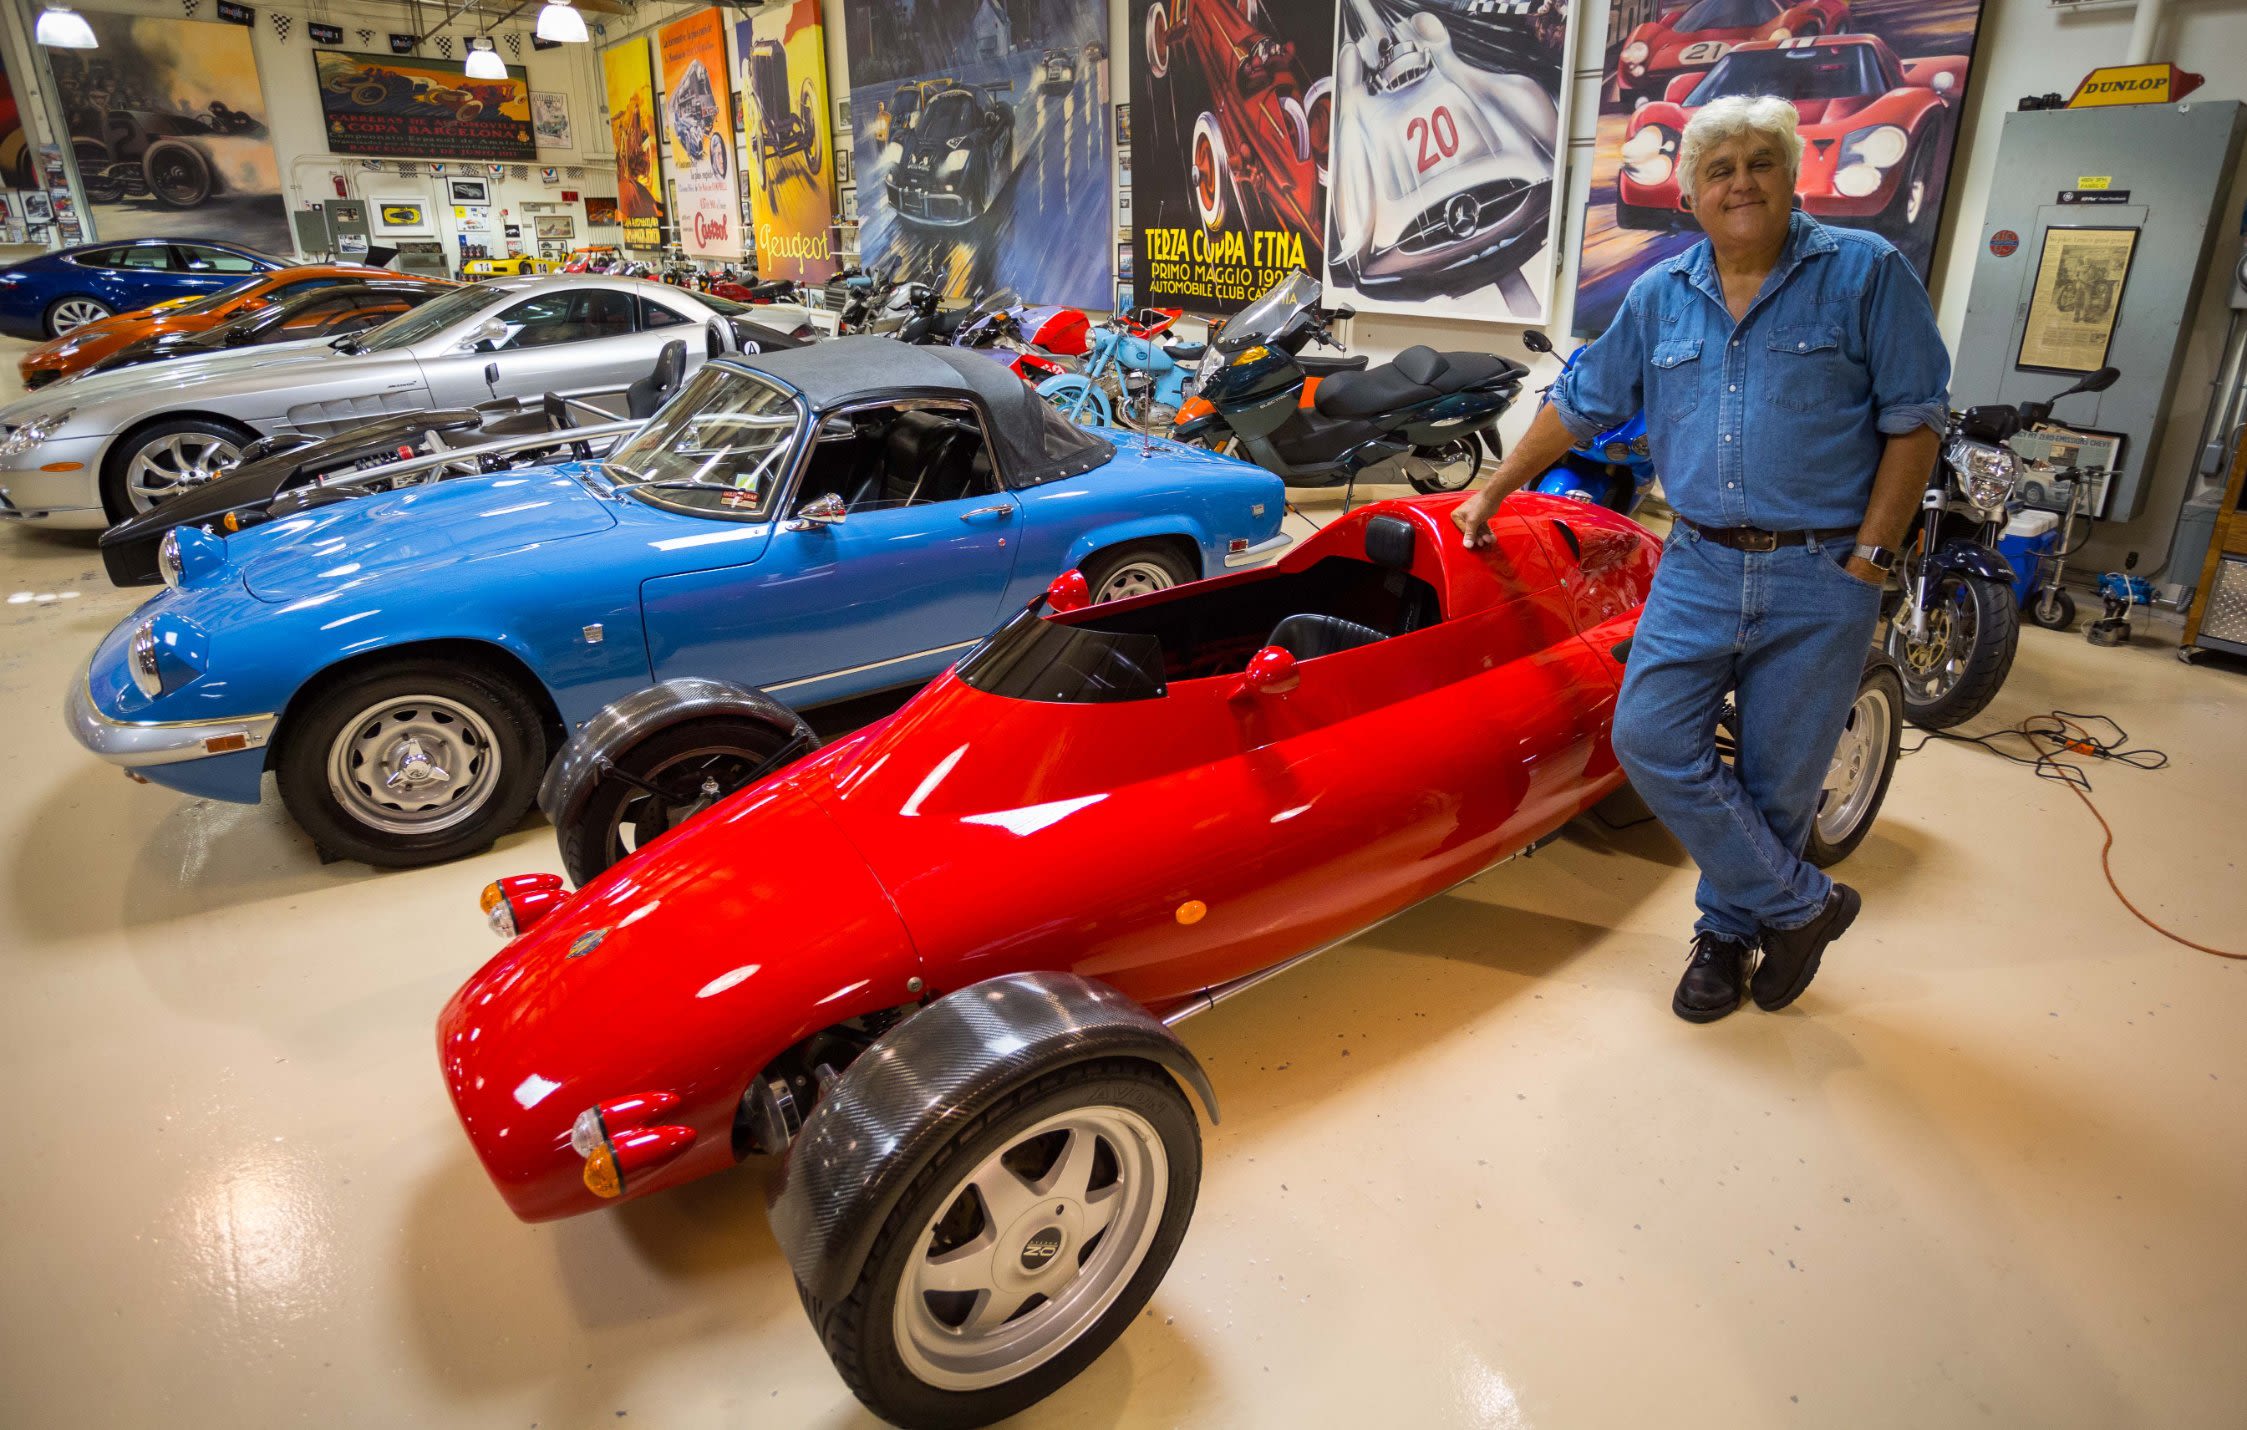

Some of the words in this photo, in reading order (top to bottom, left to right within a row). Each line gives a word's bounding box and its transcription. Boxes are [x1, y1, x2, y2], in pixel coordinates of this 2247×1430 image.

[1684, 43, 1722, 60] 21
[2084, 77, 2168, 94] DUNLOP
[347, 122, 399, 133] COPA
[408, 125, 515, 138] BARCELONA
[1406, 105, 1459, 174] 20
[695, 211, 728, 249] Castrol
[760, 223, 831, 275] Peugeot
[1145, 228, 1190, 261] TERZA
[1193, 229, 1247, 266] COPPA
[1254, 230, 1306, 269] ETNA
[1151, 262, 1190, 281] PRIMO
[1195, 265, 1252, 286] MAGGIO
[1149, 280, 1213, 298] AUTOMOBILE
[1215, 285, 1245, 300] CLUB
[1247, 287, 1298, 305] CATIA
[1086, 1085, 1170, 1115] AVON
